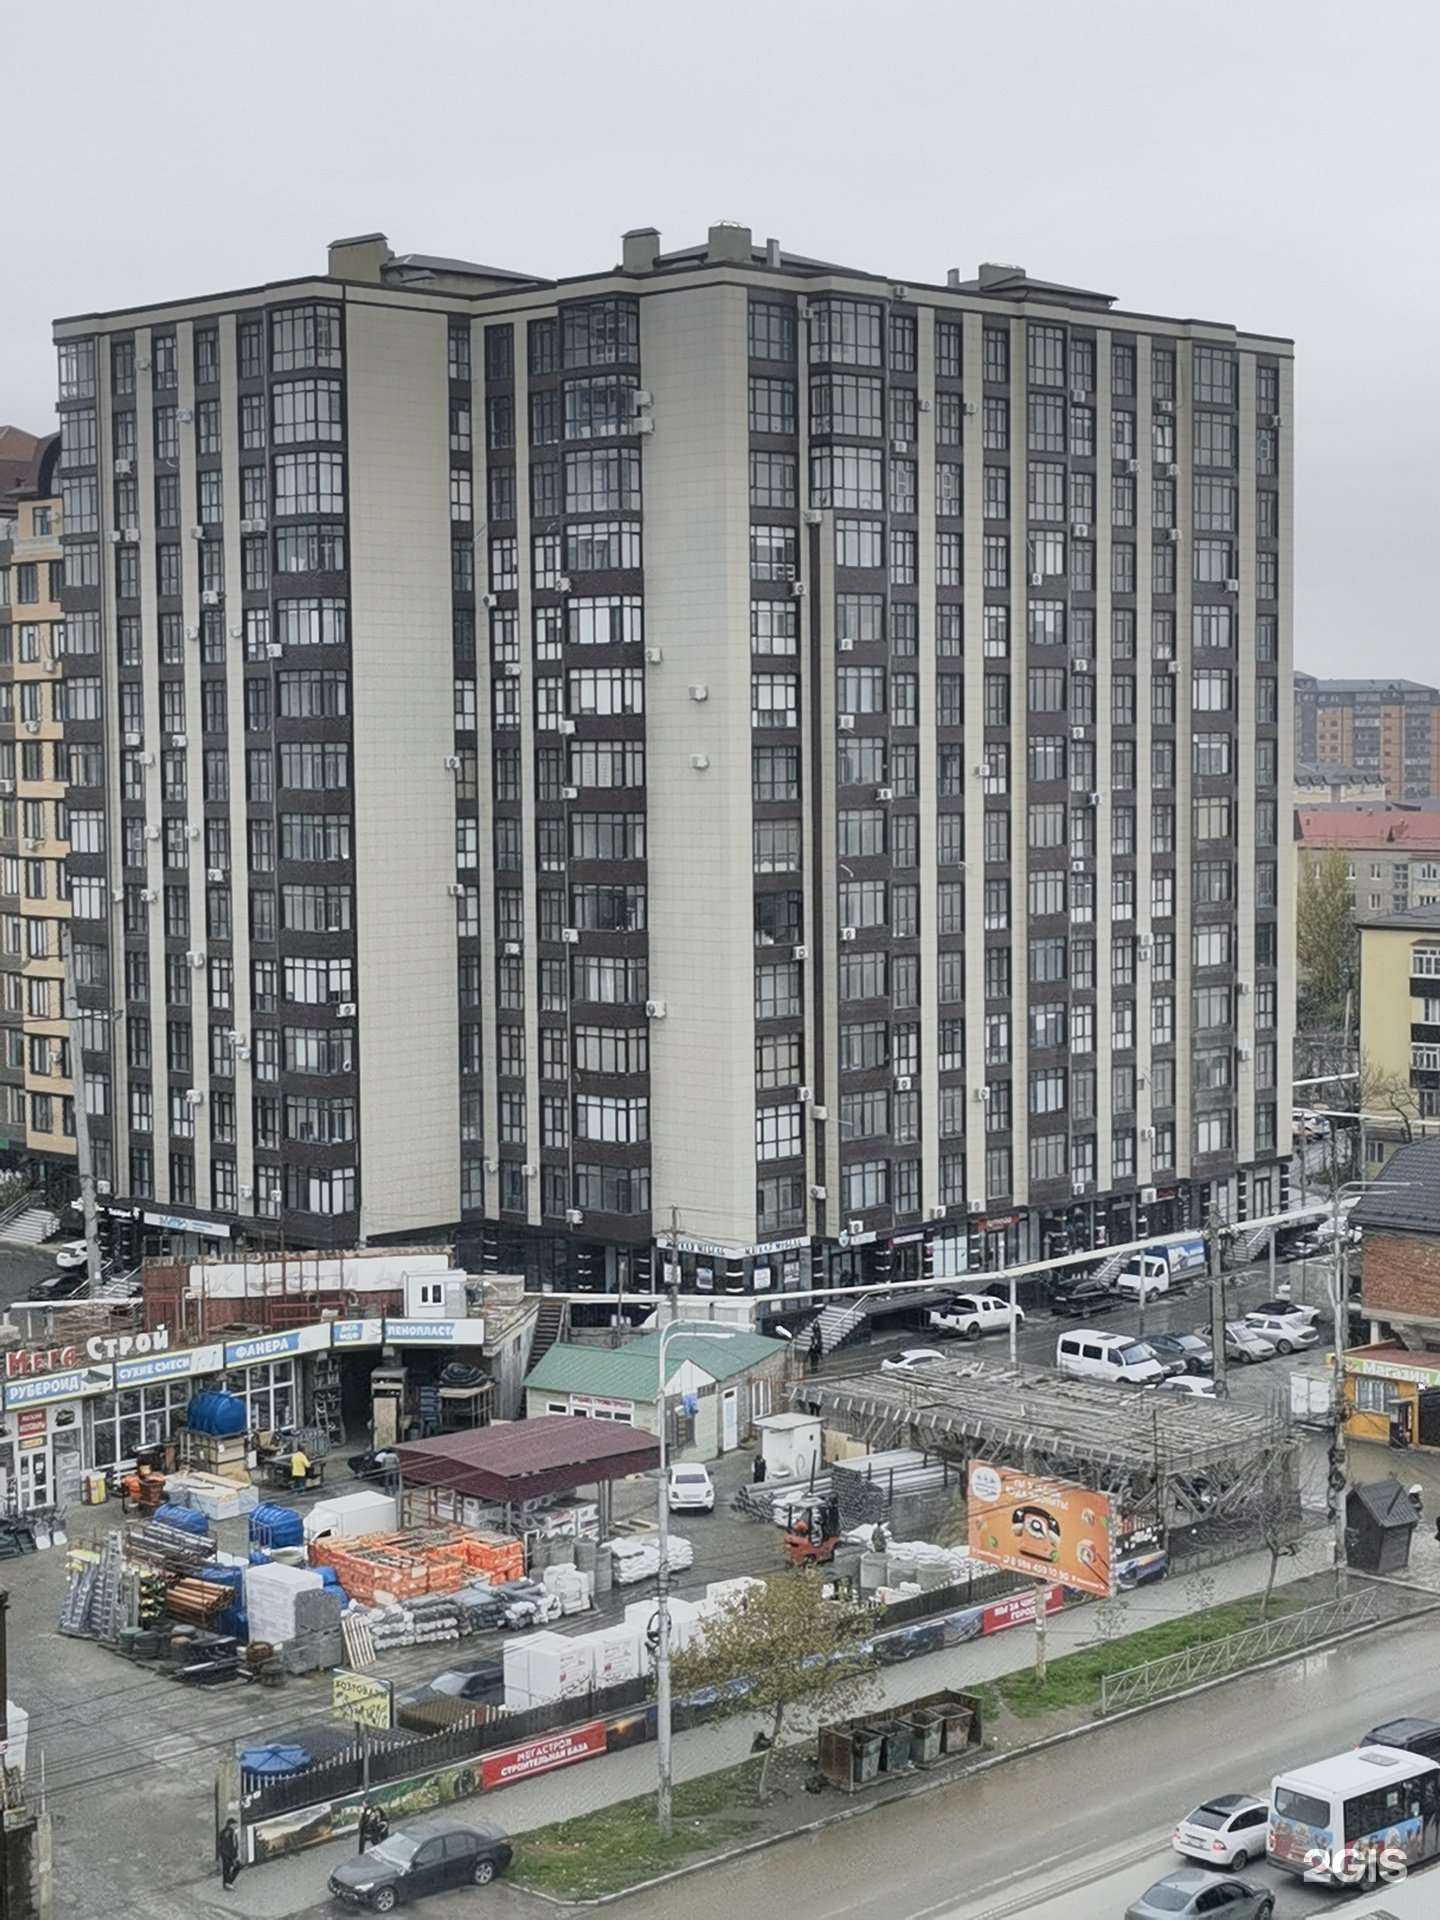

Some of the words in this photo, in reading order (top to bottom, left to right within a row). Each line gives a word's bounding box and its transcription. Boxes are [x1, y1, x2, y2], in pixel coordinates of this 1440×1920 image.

[235, 1337, 290, 1359] ФАНЕРА
[118, 1363, 153, 1380] СУХИЕ
[154, 1358, 191, 1374] СМЕСИ
[10, 1374, 80, 1400] РУБЕРОИД
